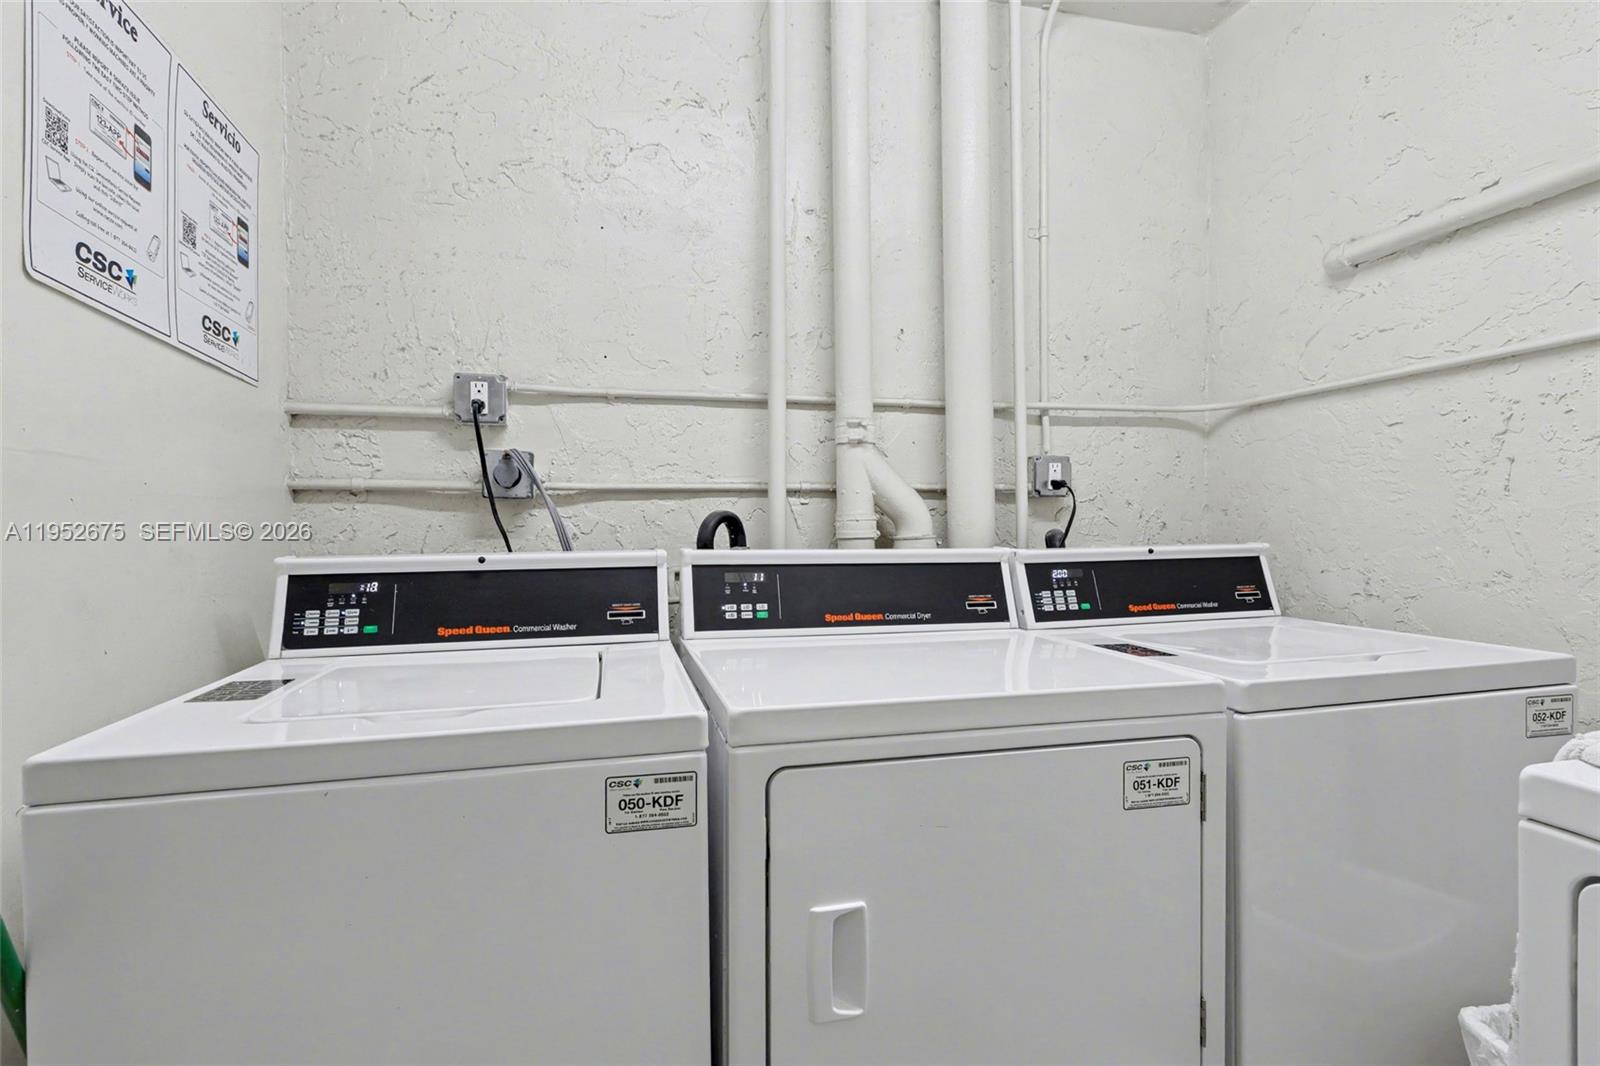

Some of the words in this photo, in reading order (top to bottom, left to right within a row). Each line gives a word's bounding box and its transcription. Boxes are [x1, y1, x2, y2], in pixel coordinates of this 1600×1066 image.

[96, 0, 138, 42] rvice
[202, 100, 241, 154] Servicio
[75, 242, 122, 281] CSC
[202, 315, 232, 342] CSC
[1128, 602, 1152, 612] Speed
[825, 612, 854, 623] Speed
[854, 612, 883, 620] Queen
[916, 612, 932, 620] Dryer
[437, 626, 473, 637] Speed
[475, 625, 512, 634] Queen
[513, 624, 551, 633] Commercial
[1532, 710, 1567, 722] 052-KDF
[608, 780, 632, 788] CSC
[1133, 776, 1180, 791] 051-KDF
[618, 794, 684, 811] 050-KDF
